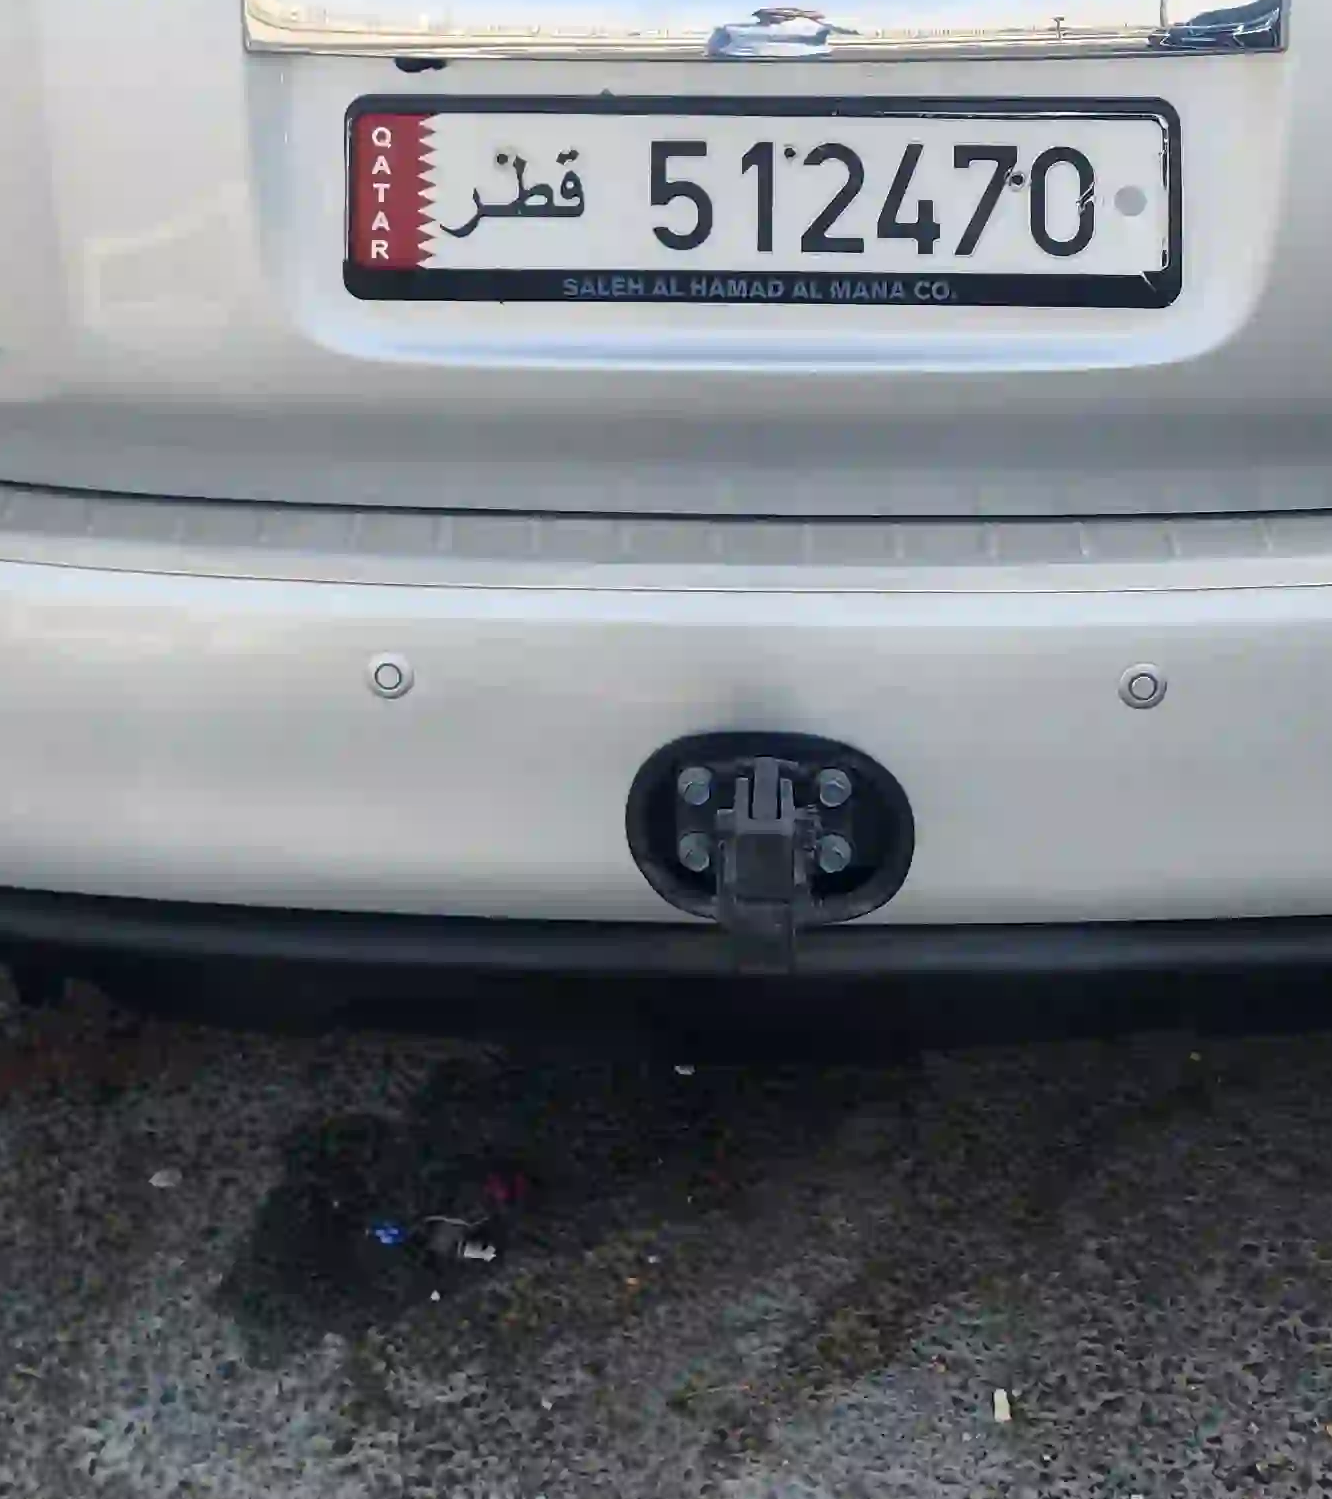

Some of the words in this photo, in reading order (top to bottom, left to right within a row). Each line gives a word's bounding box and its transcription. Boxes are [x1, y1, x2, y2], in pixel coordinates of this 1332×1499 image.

[370, 126, 391, 261] QATAR
[439, 147, 587, 239] قطر
[649, 138, 1097, 259] 512470
[562, 277, 645, 298] SALEH
[650, 278, 685, 299] AL
[689, 277, 785, 300] HAMAD
[790, 278, 823, 300] AL
[829, 279, 905, 301] MANA
[912, 279, 958, 302] CO.
